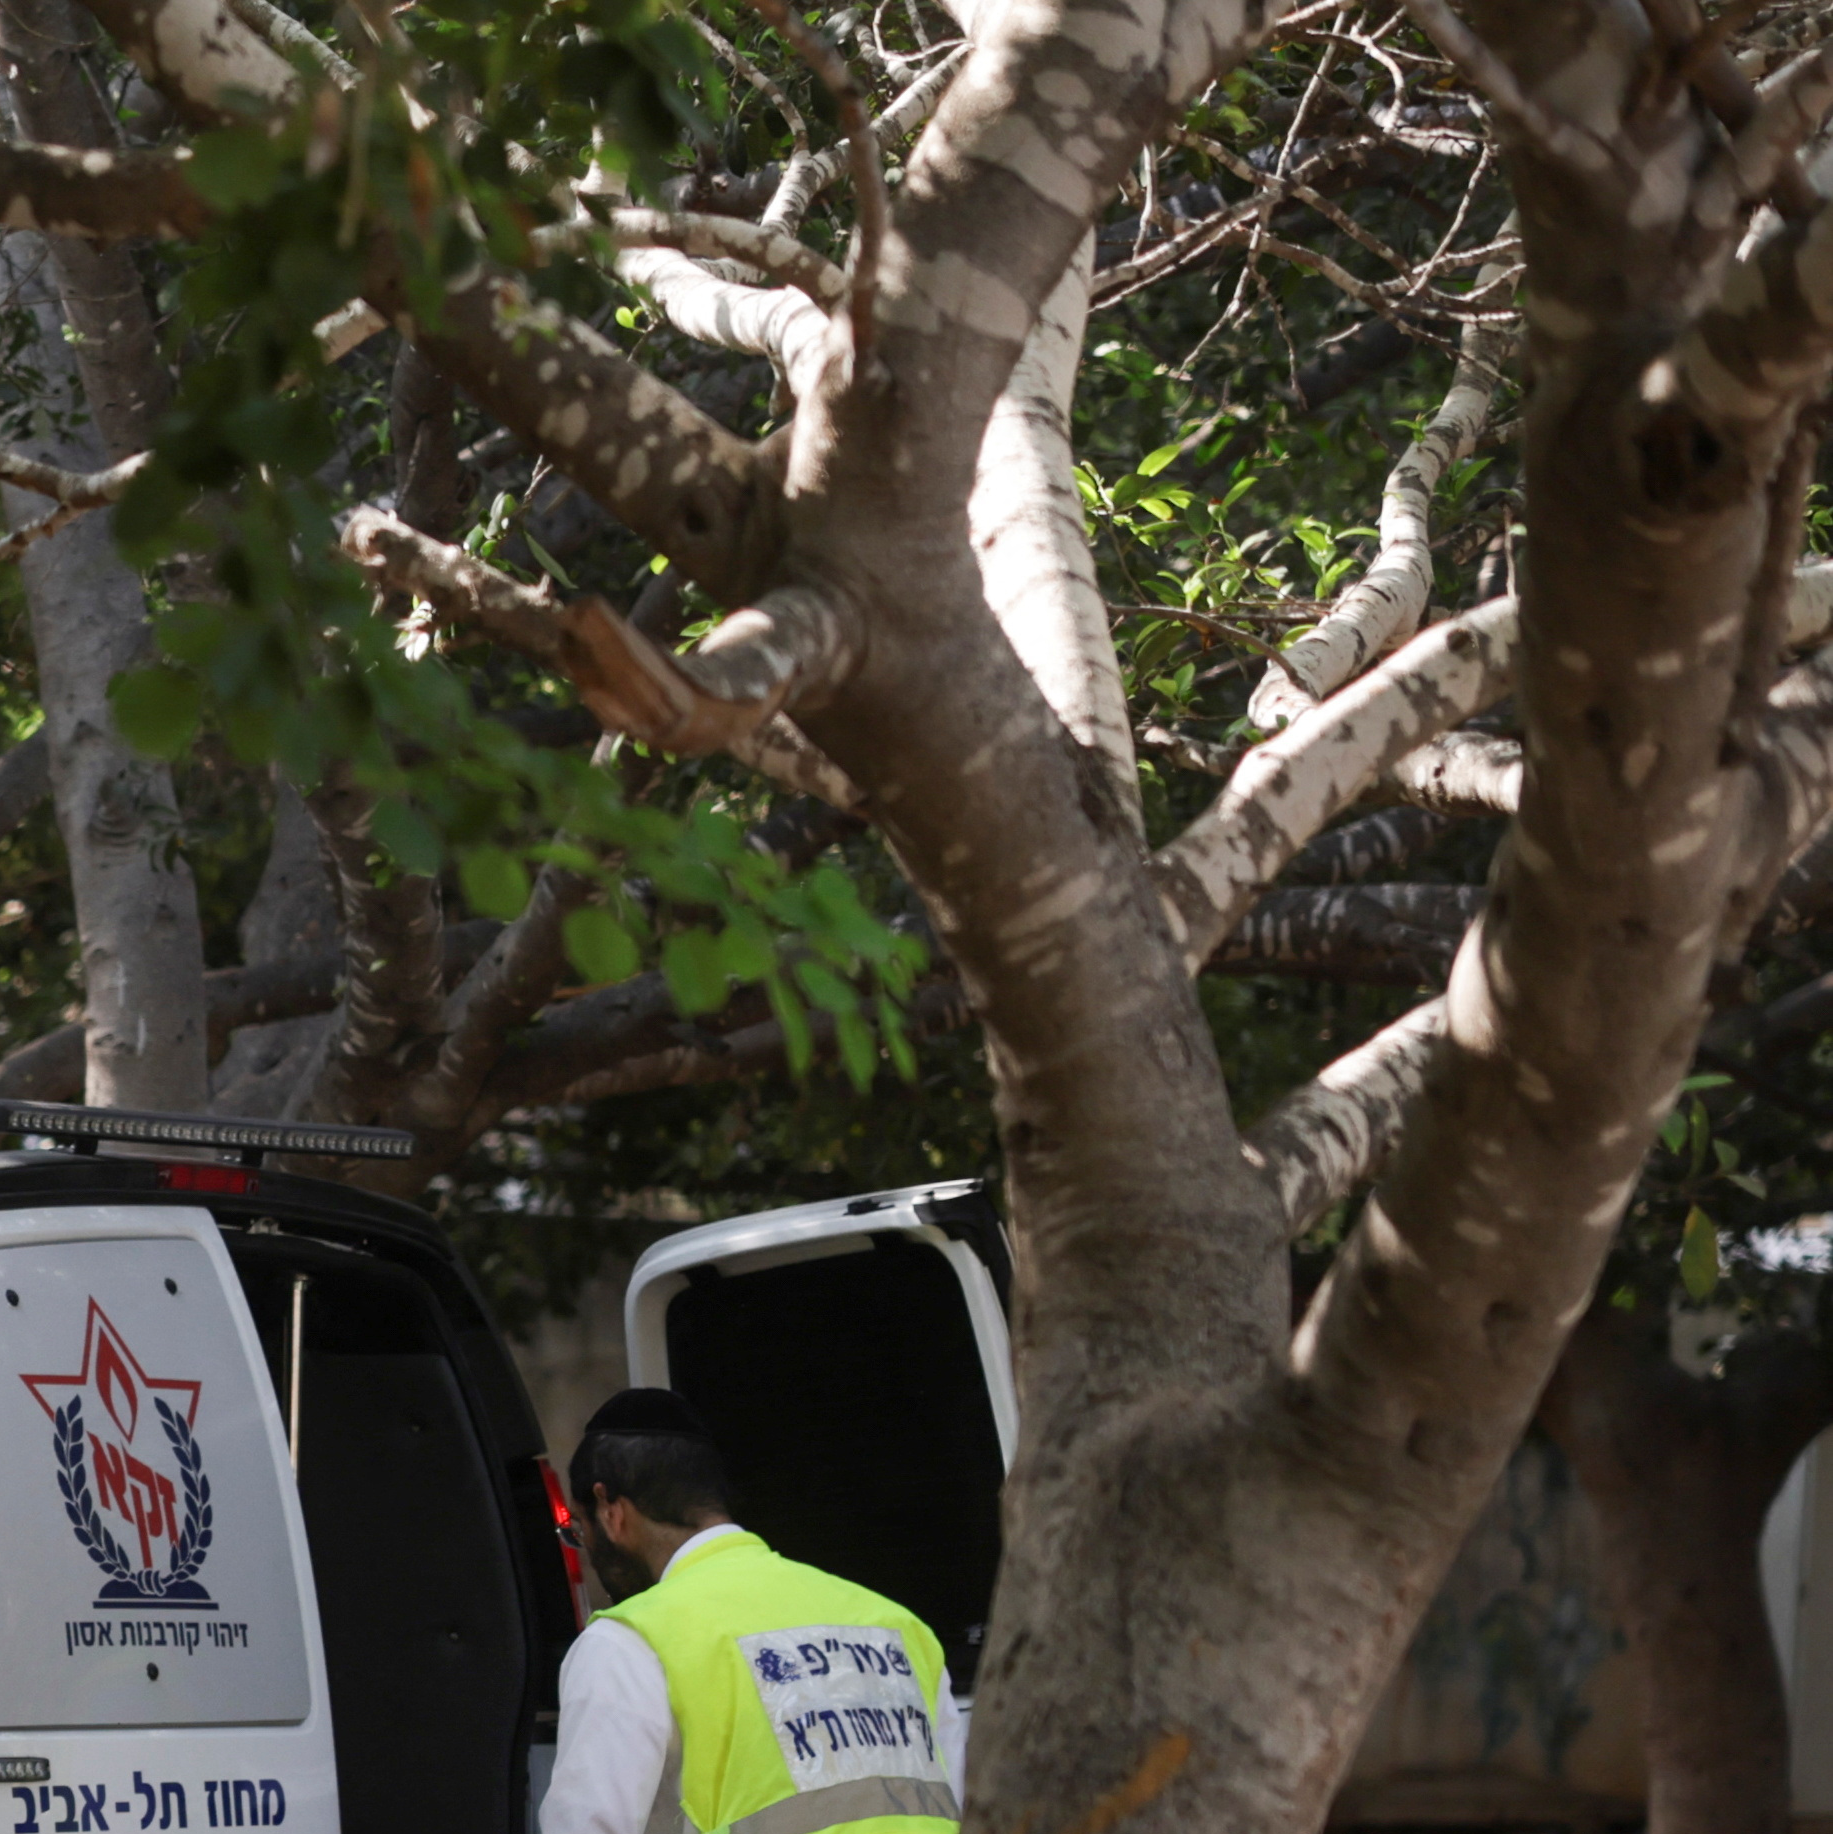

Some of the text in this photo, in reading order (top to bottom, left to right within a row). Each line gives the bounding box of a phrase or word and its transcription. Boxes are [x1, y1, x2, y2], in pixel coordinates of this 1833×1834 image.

[65, 1621, 248, 1656] זיהוי קורבנות אסון
[12, 1771, 286, 1834] מחוז תל-אביב
